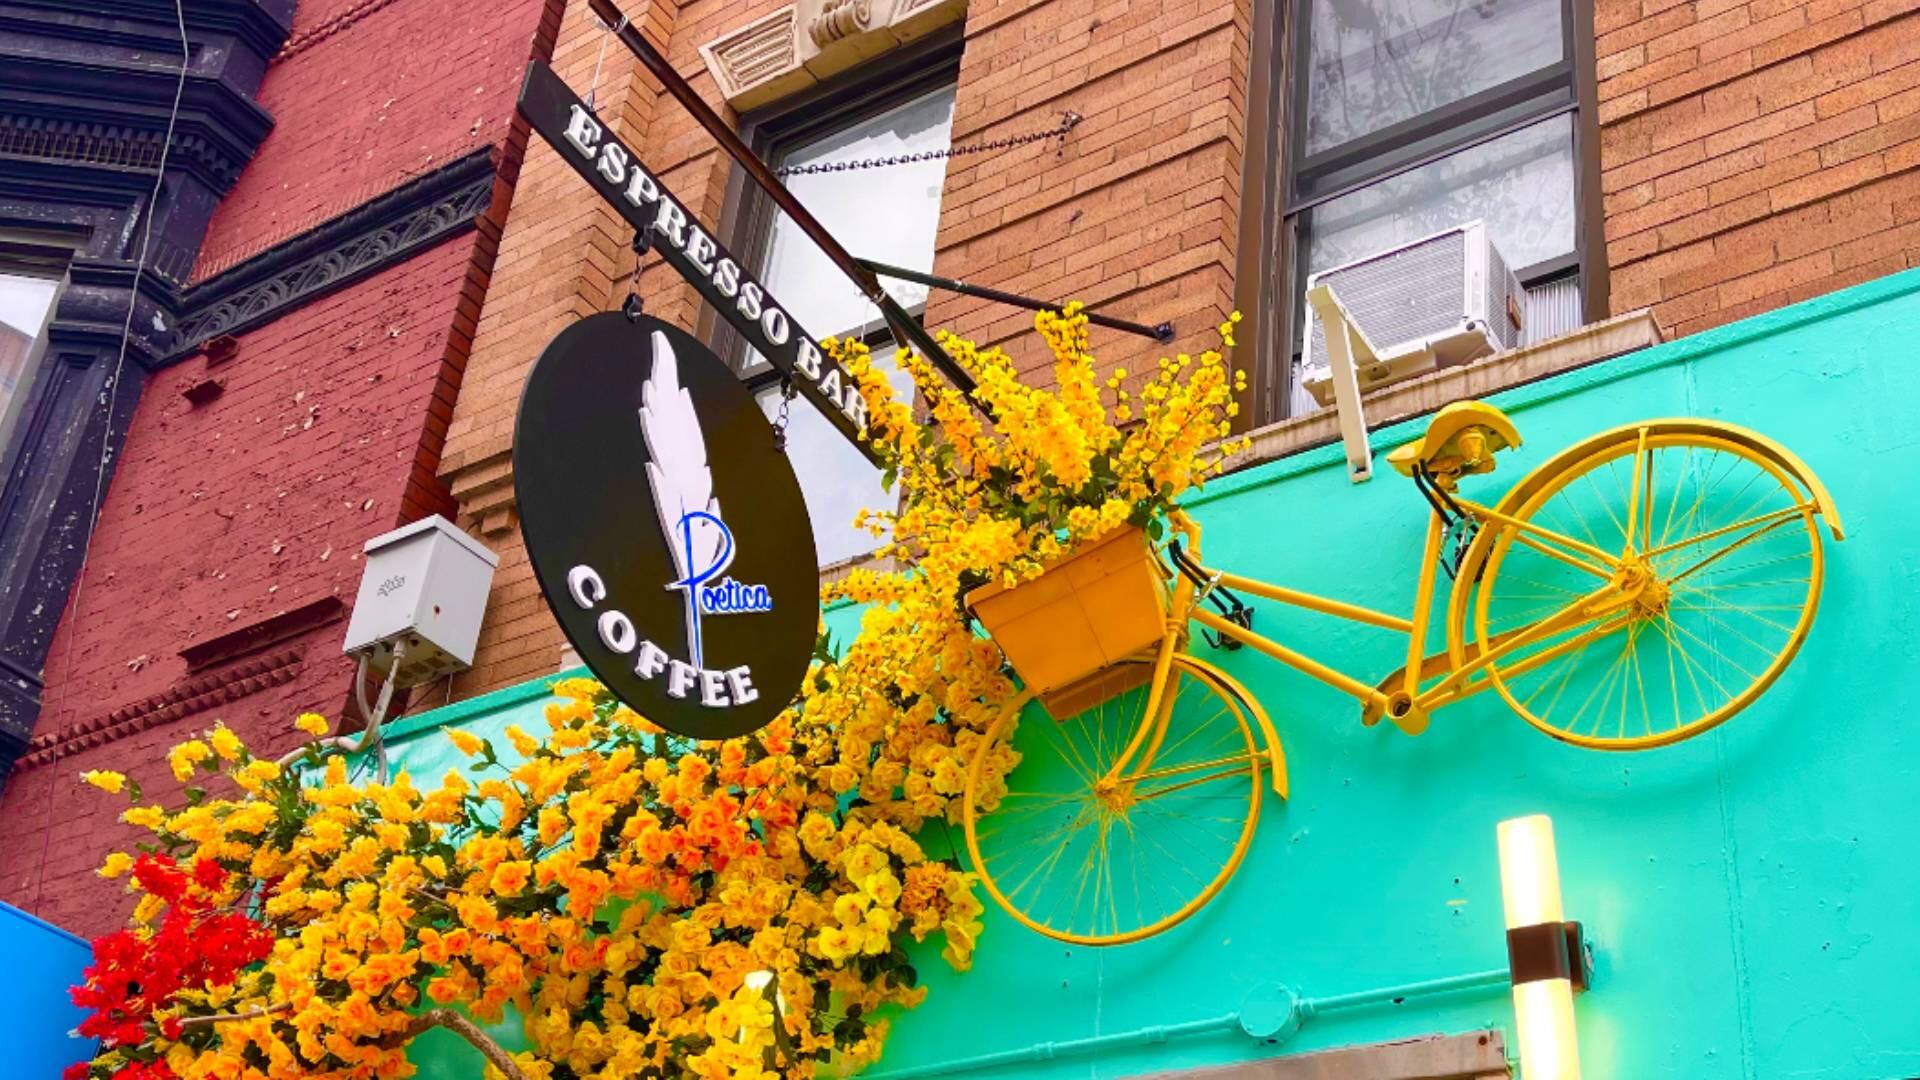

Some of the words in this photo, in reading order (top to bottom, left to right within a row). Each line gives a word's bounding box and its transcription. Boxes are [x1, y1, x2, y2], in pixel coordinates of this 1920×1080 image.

[563, 103, 790, 346] ESPRESSO
[794, 336, 869, 432] BAR
[567, 564, 759, 708] COFFEE
[664, 511, 773, 671] Poetica
